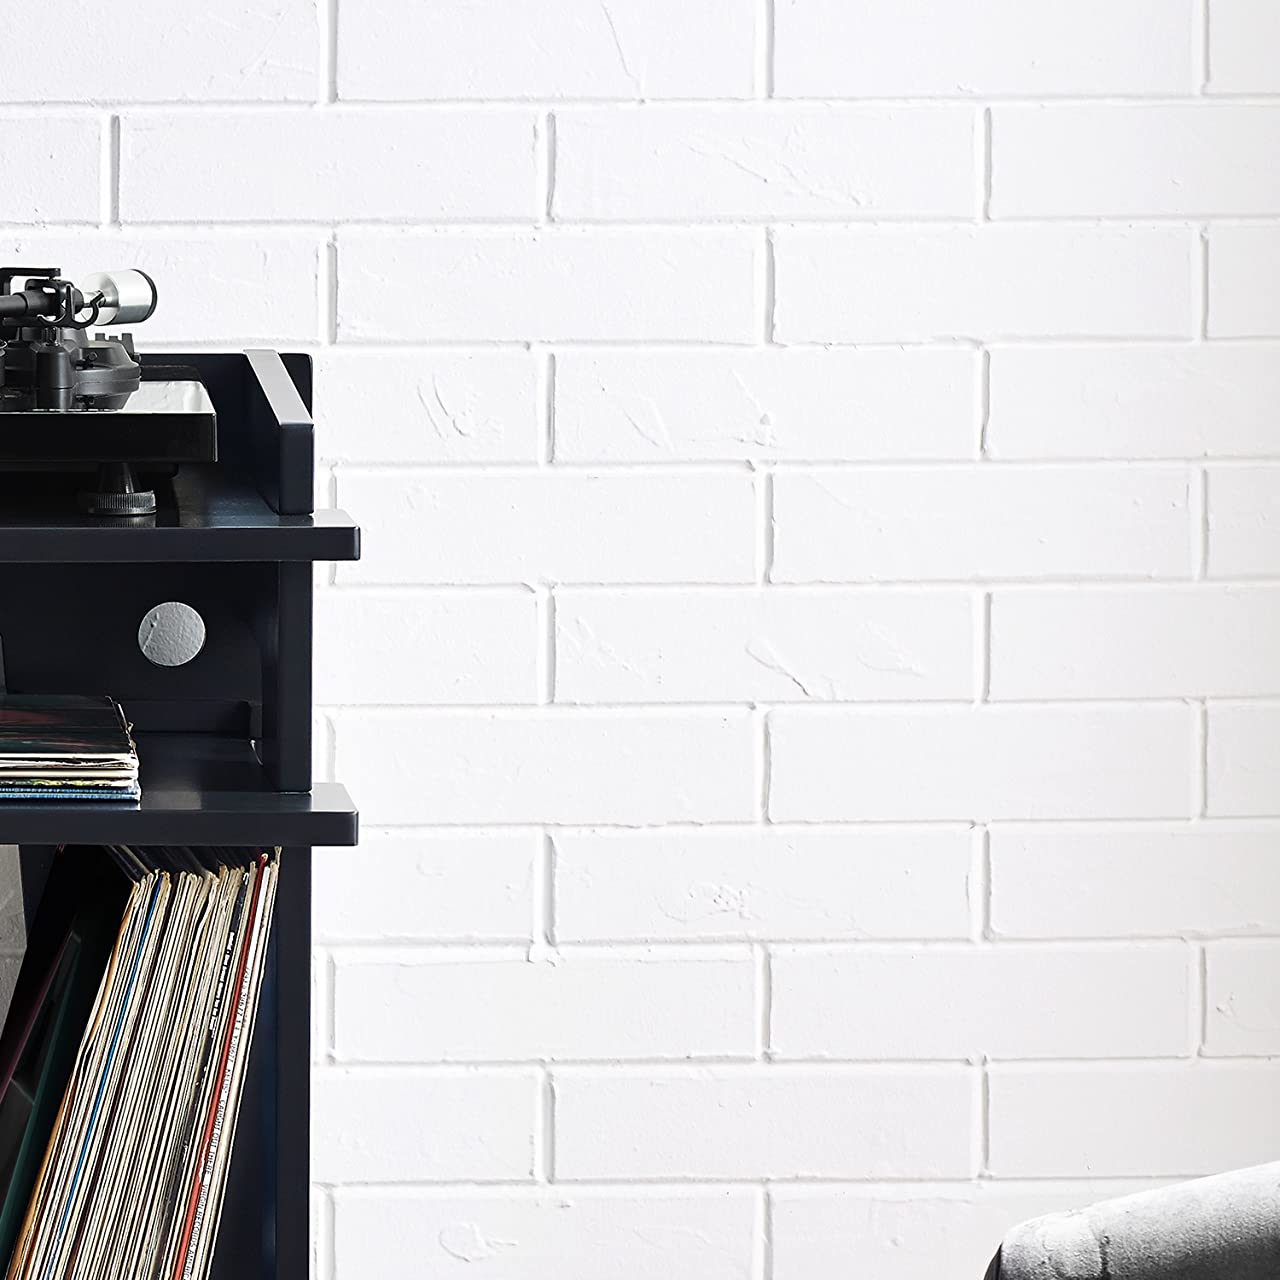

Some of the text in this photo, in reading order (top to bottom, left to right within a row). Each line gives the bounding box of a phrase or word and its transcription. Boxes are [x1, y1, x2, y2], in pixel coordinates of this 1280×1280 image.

[212, 1099, 226, 1130] CAUGHT
[209, 1131, 219, 1147] OUT
[203, 1150, 215, 1175] THERE
[196, 1182, 209, 1210] VIRGIN
[188, 1210, 203, 1248] RECORDS
